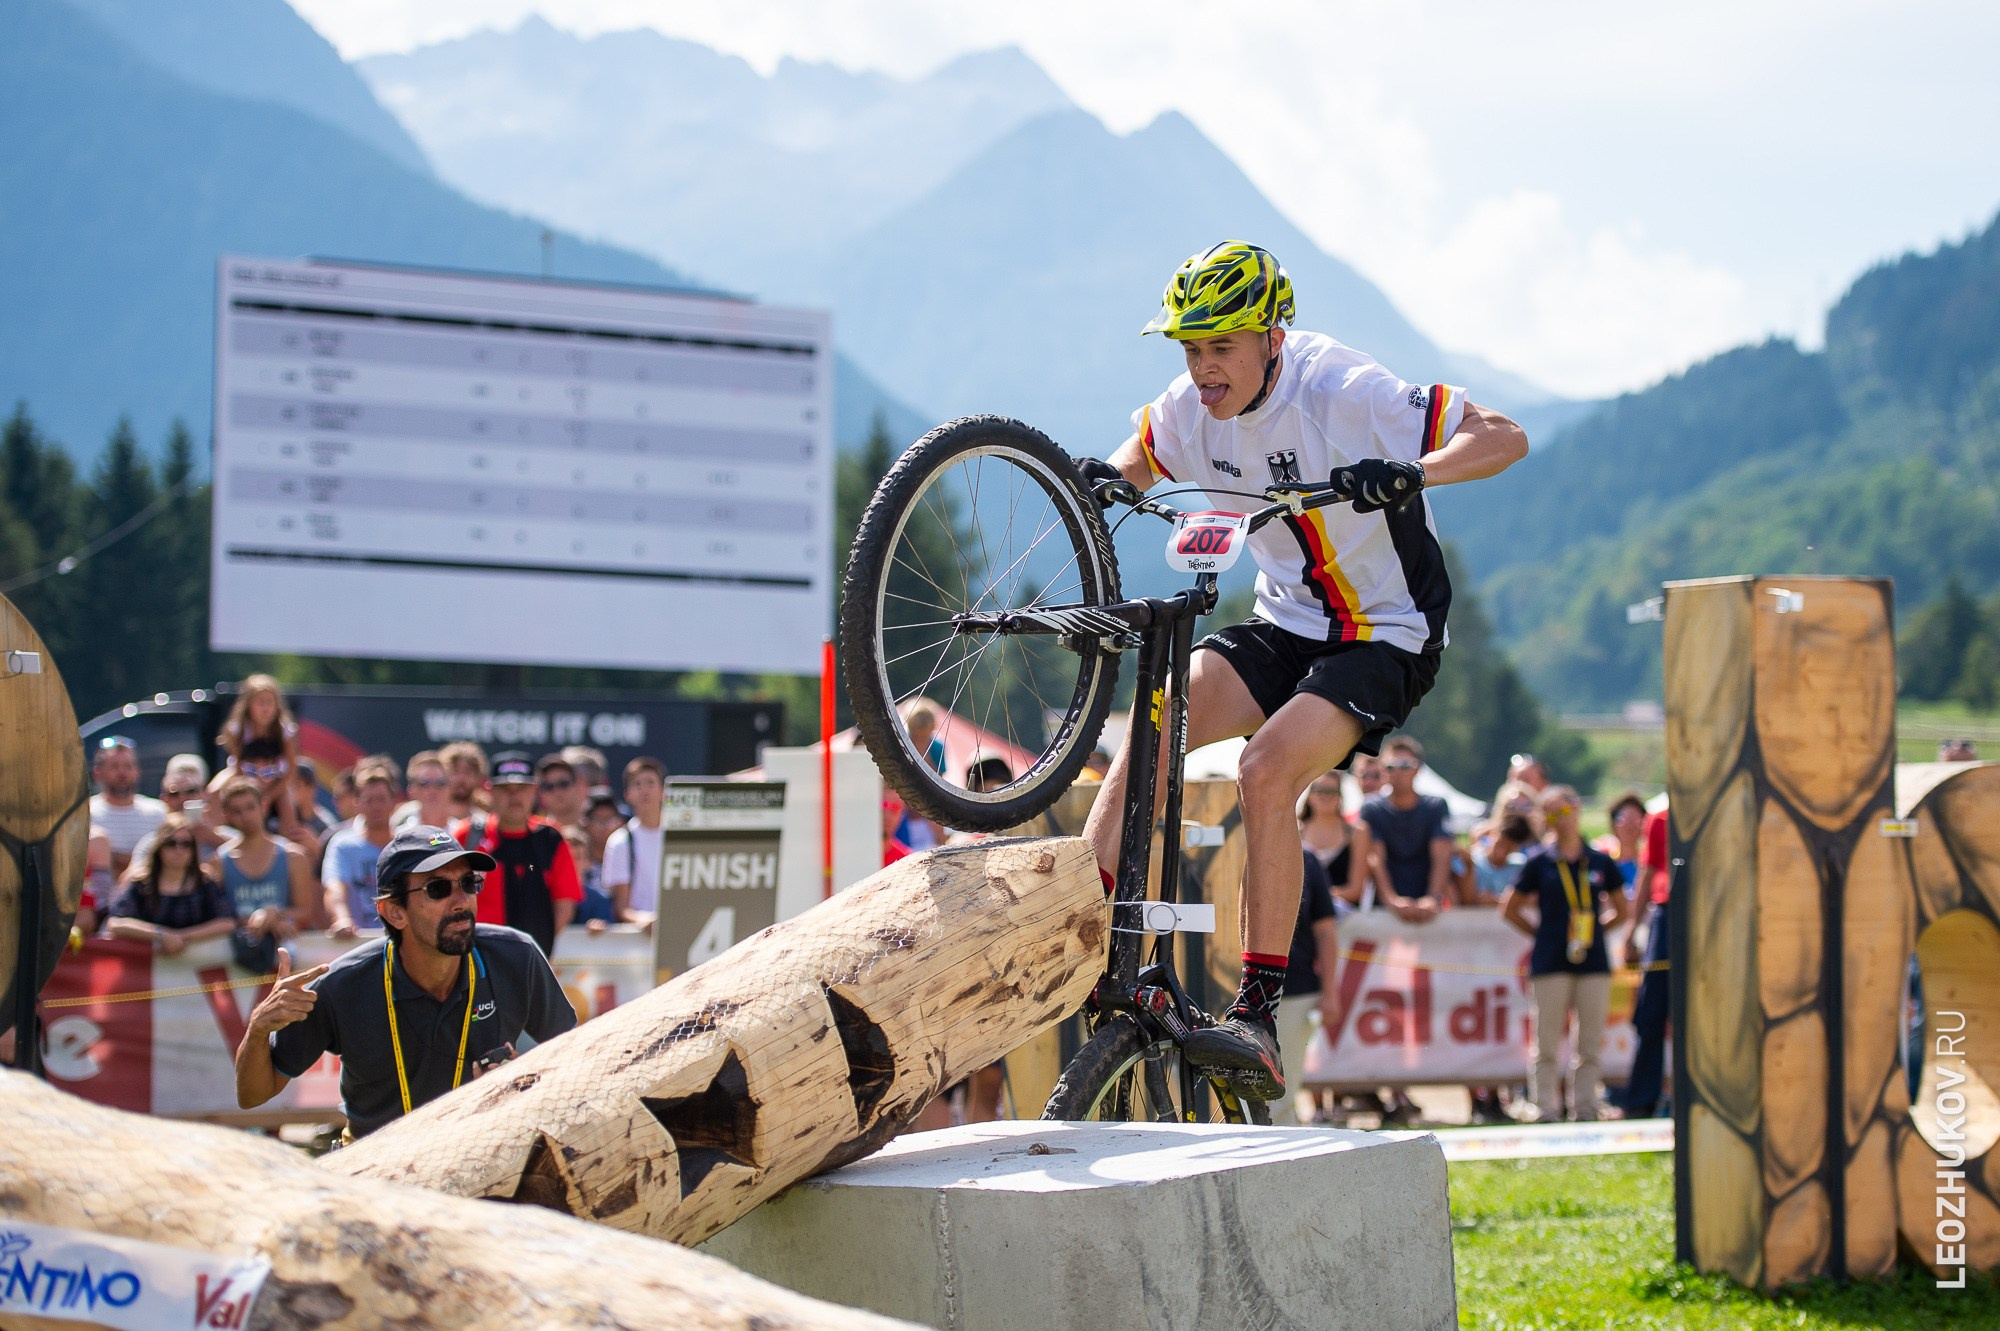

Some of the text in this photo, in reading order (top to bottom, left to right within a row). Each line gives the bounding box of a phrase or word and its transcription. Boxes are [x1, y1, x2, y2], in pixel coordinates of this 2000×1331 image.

[1182, 528, 1230, 553] 207
[1187, 559, 1216, 570] TRENTINO
[423, 708, 647, 747] WATCH IT ON
[663, 853, 777, 891] FINISH
[687, 905, 736, 969] 4
[1450, 985, 1508, 1044] di
[195, 1273, 252, 1329] Val
